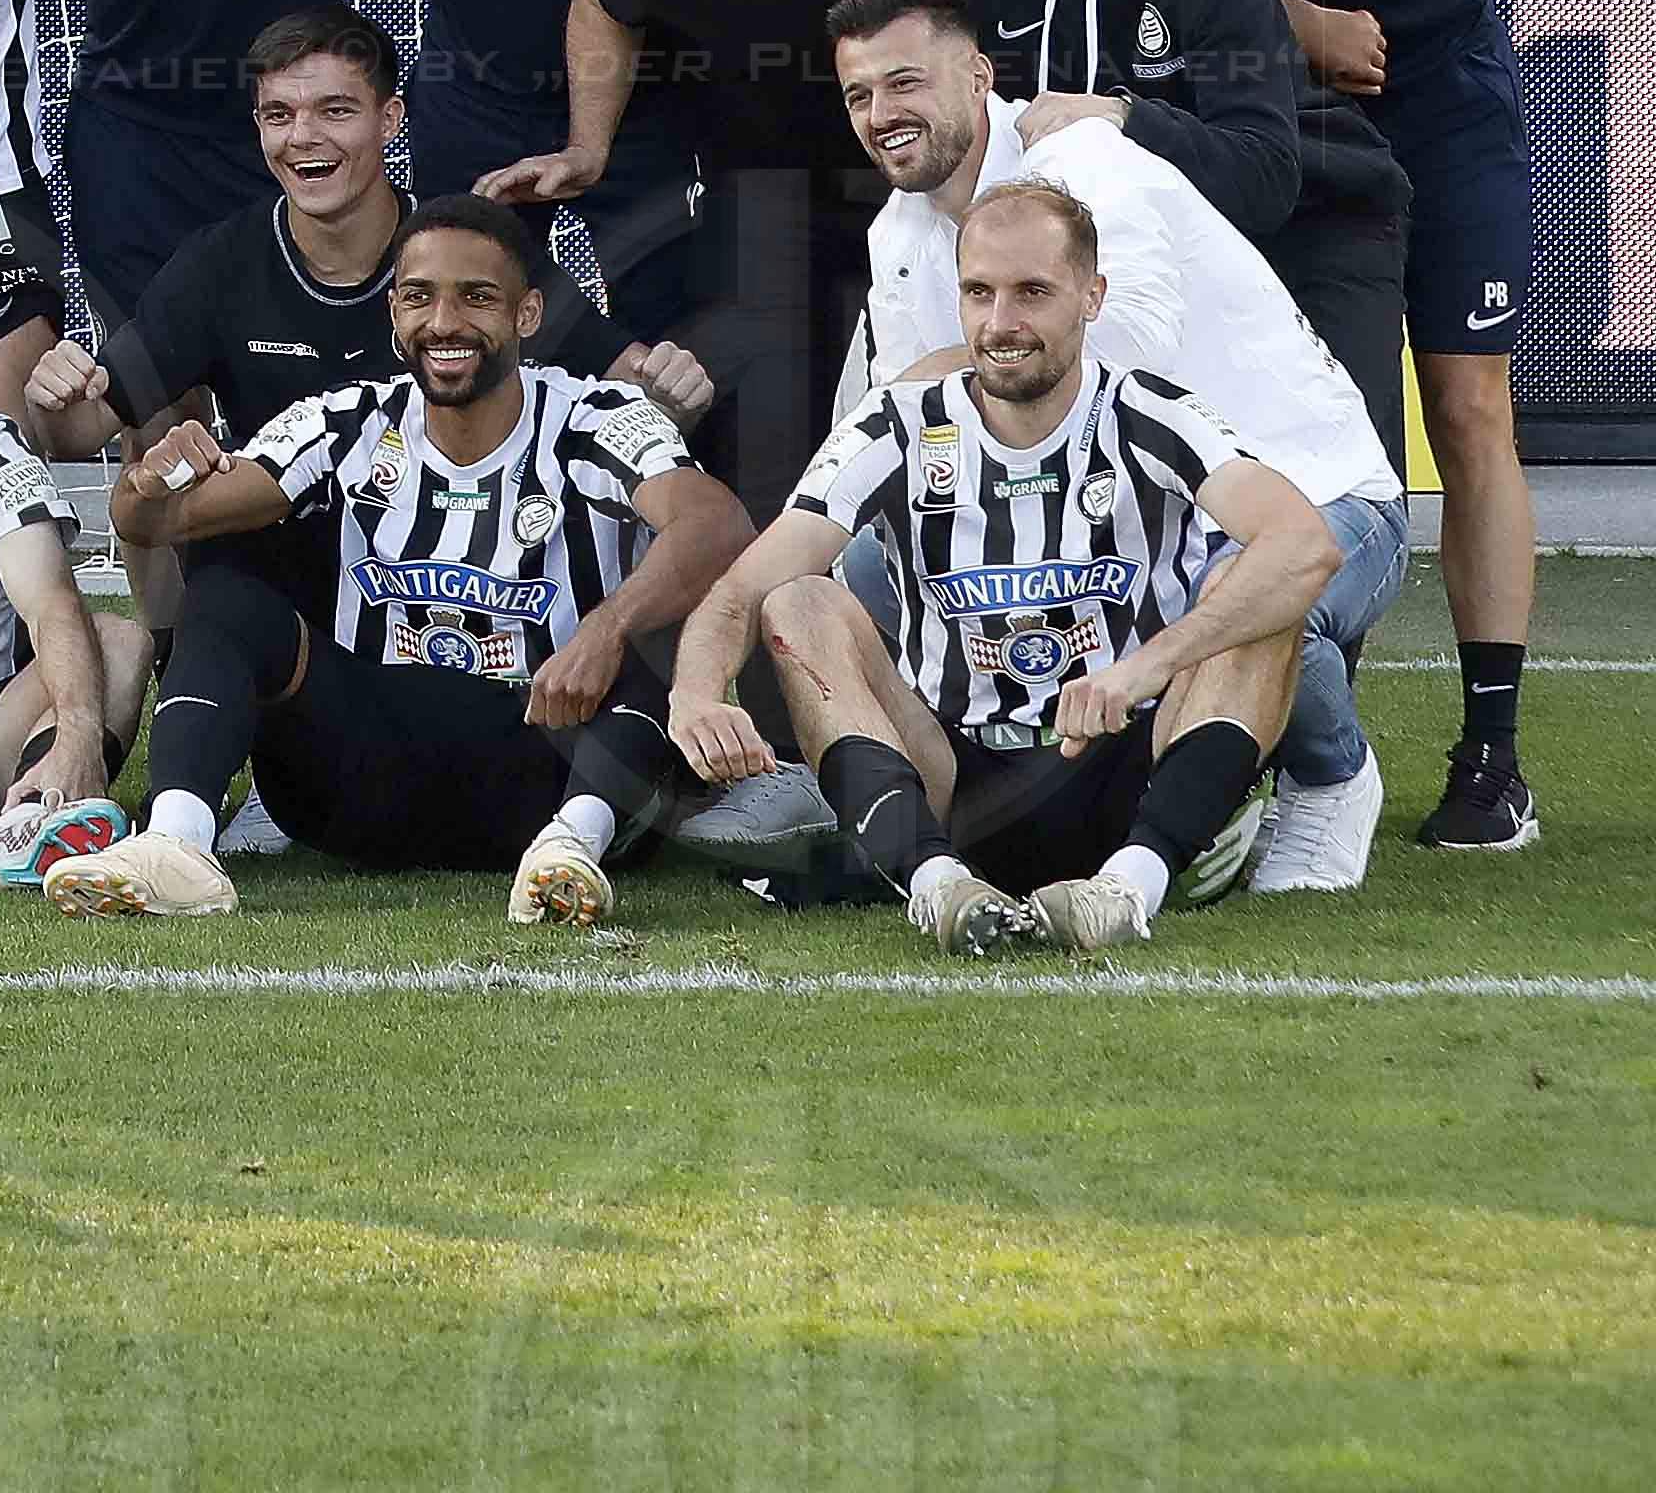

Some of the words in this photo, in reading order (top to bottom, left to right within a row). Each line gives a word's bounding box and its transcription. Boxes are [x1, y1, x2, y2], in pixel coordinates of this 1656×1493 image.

[1483, 281, 1510, 309] PB
[1011, 475, 1061, 496] GRAWE
[448, 495, 491, 513] GRAWE
[367, 560, 550, 616] PUNTIGAMER
[936, 563, 1131, 615] PUNTIGAMER
